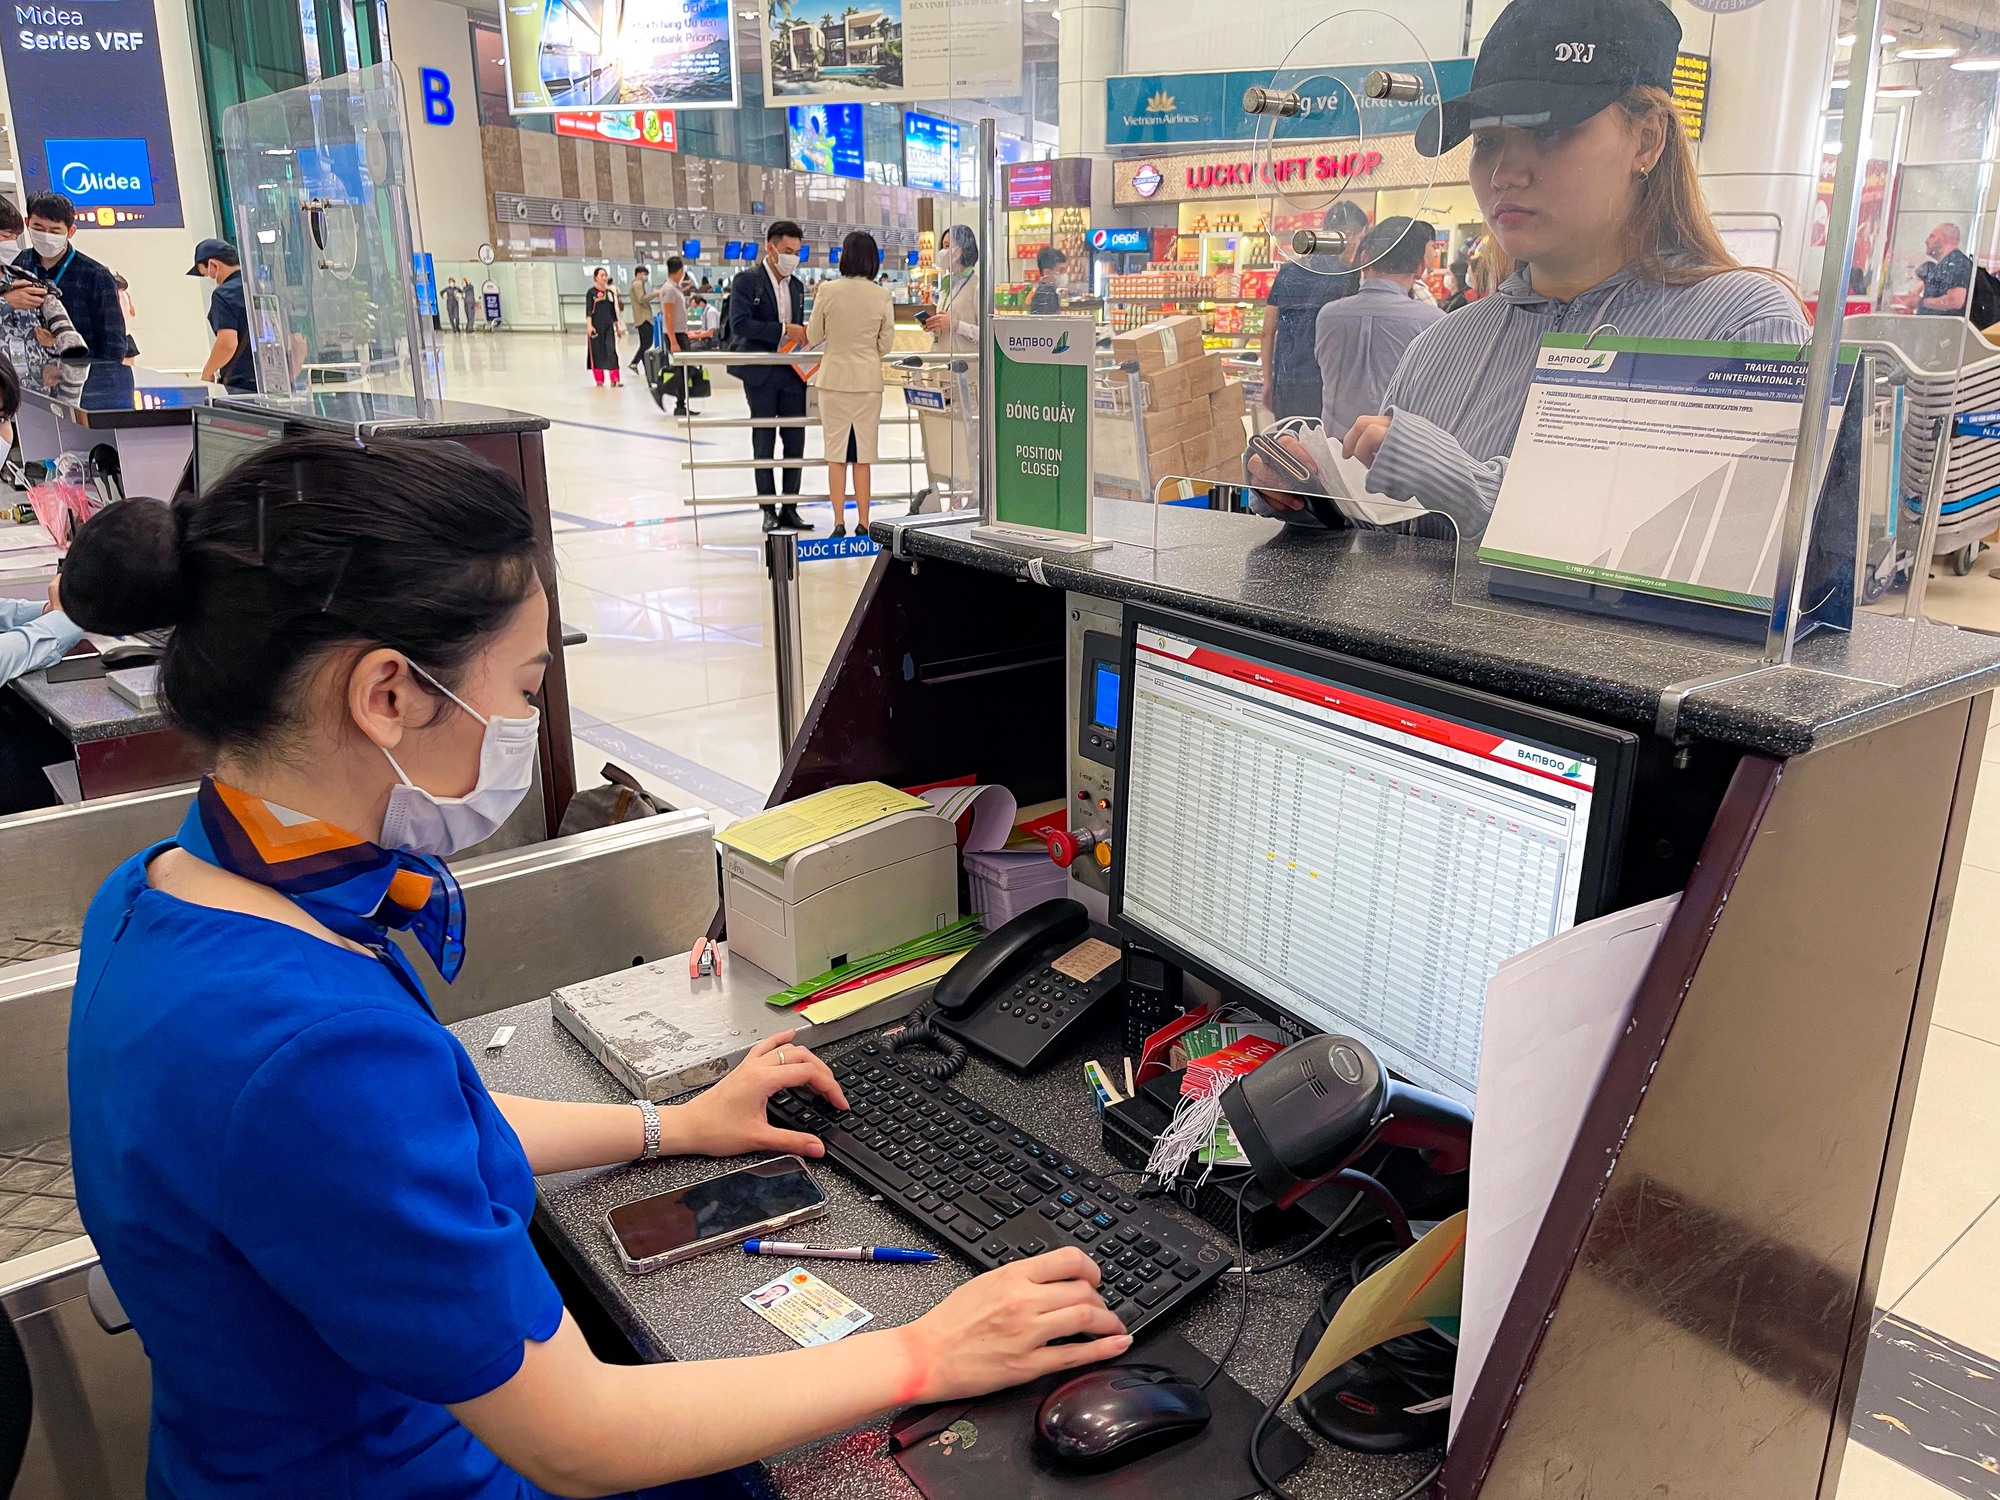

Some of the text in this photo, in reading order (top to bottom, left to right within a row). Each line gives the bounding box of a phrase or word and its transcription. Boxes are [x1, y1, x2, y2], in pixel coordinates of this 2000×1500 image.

[14, 4, 84, 26] Midea
[19, 30, 144, 51] Series VRF
[1554, 42, 1596, 63] DYJ
[422, 66, 456, 126] B
[1316, 90, 1339, 110] vé
[1123, 114, 1198, 126] Vietnam Airlines
[65, 166, 140, 192] Midea
[1186, 150, 1381, 188] LUCKY GIFT SHOP
[1112, 231, 1140, 246] pepsi
[1009, 336, 1053, 348] BAMBOO
[1548, 354, 1590, 364] BAMBOO
[1744, 362, 1778, 373] TRAVEL
[1708, 372, 1721, 380] ON
[1722, 373, 1794, 386] INTERNATIONAL
[1006, 400, 1076, 424] ĐÓNG QUẦY
[1016, 444, 1062, 462] POSITION
[1021, 462, 1060, 478] CLOSED
[798, 540, 829, 558] QUỐC
[834, 540, 846, 555] TẾ
[850, 541, 870, 556] NỘI
[1517, 749, 1565, 771] BAMBOO
[1280, 1016, 1304, 1039] DELL
